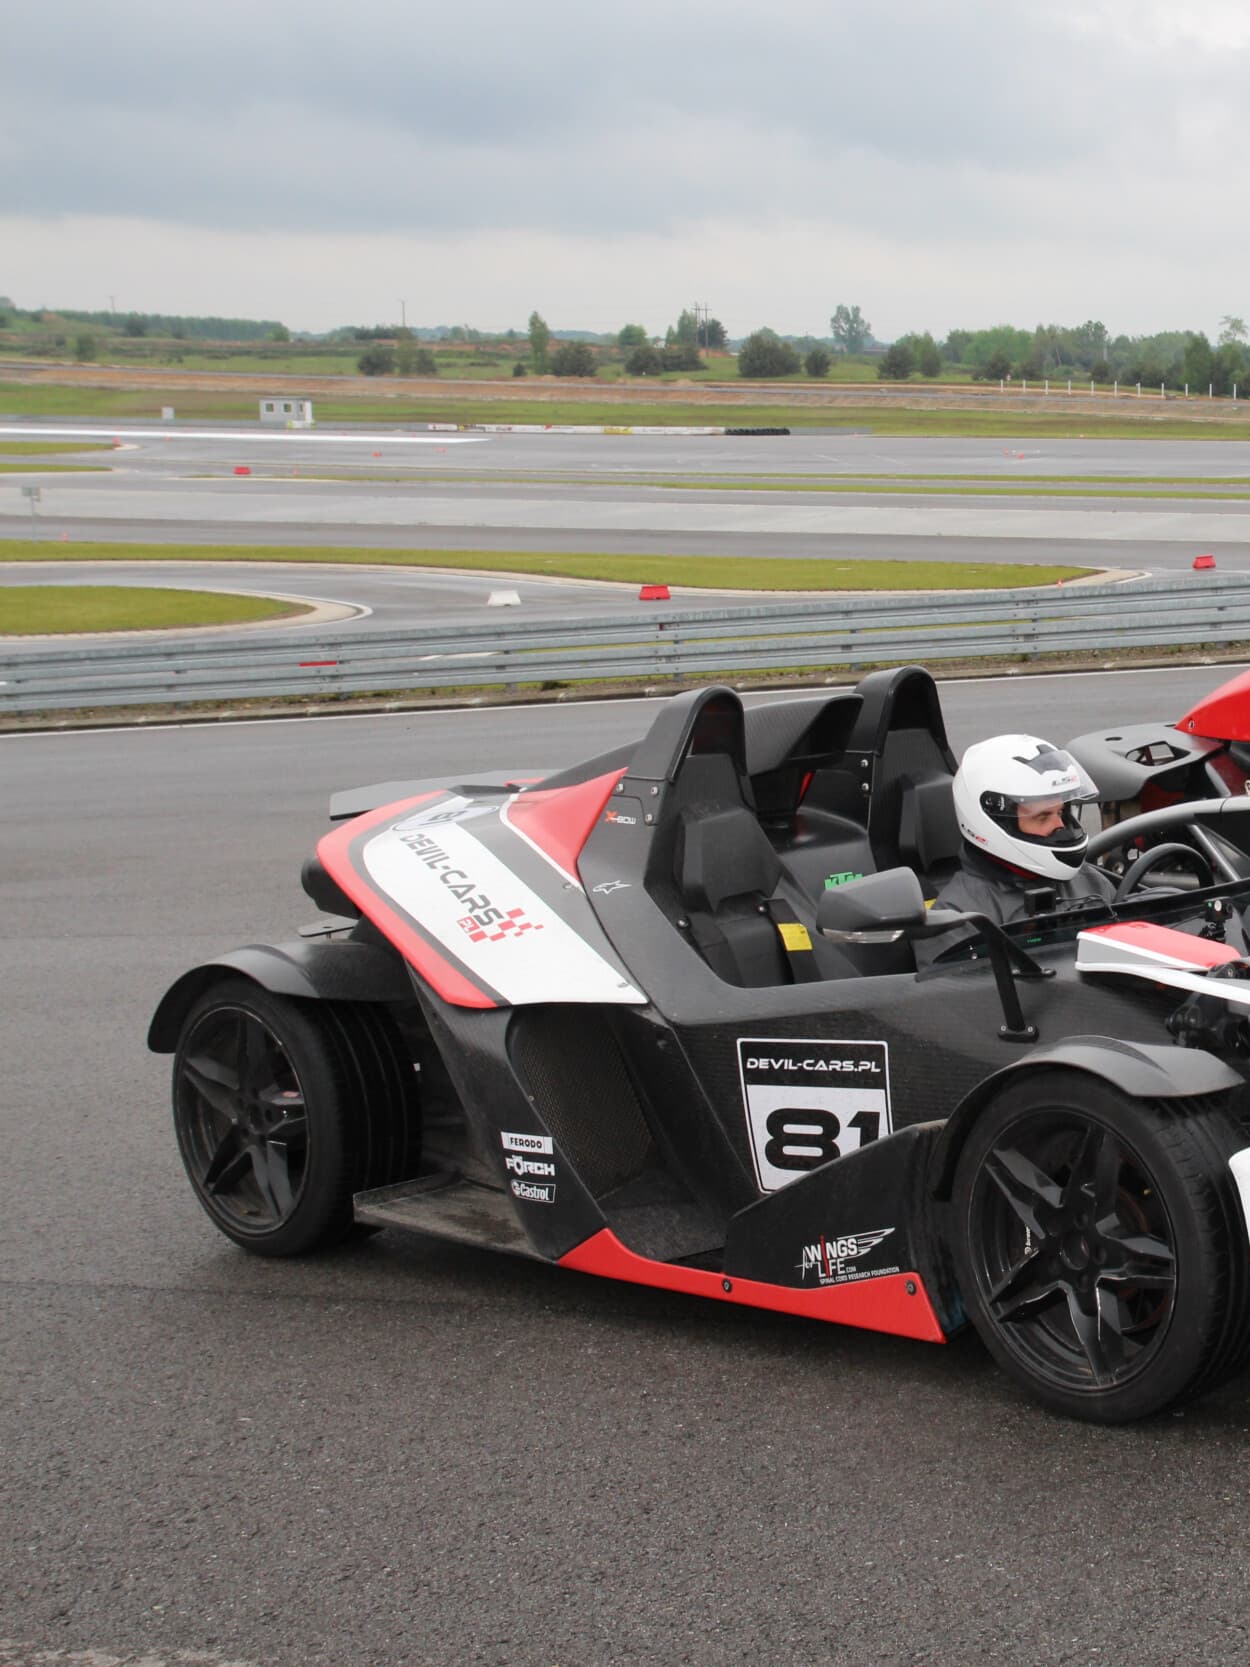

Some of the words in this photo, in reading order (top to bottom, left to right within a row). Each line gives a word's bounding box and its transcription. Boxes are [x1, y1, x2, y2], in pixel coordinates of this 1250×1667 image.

[400, 833, 504, 926] DEVIL-CARS
[746, 1058, 881, 1073] DEVIL-CARS.PL
[510, 1137, 543, 1149] FERODO
[765, 1108, 880, 1172] 81
[520, 1183, 550, 1201] Castrol
[805, 1236, 858, 1262] WINGS
